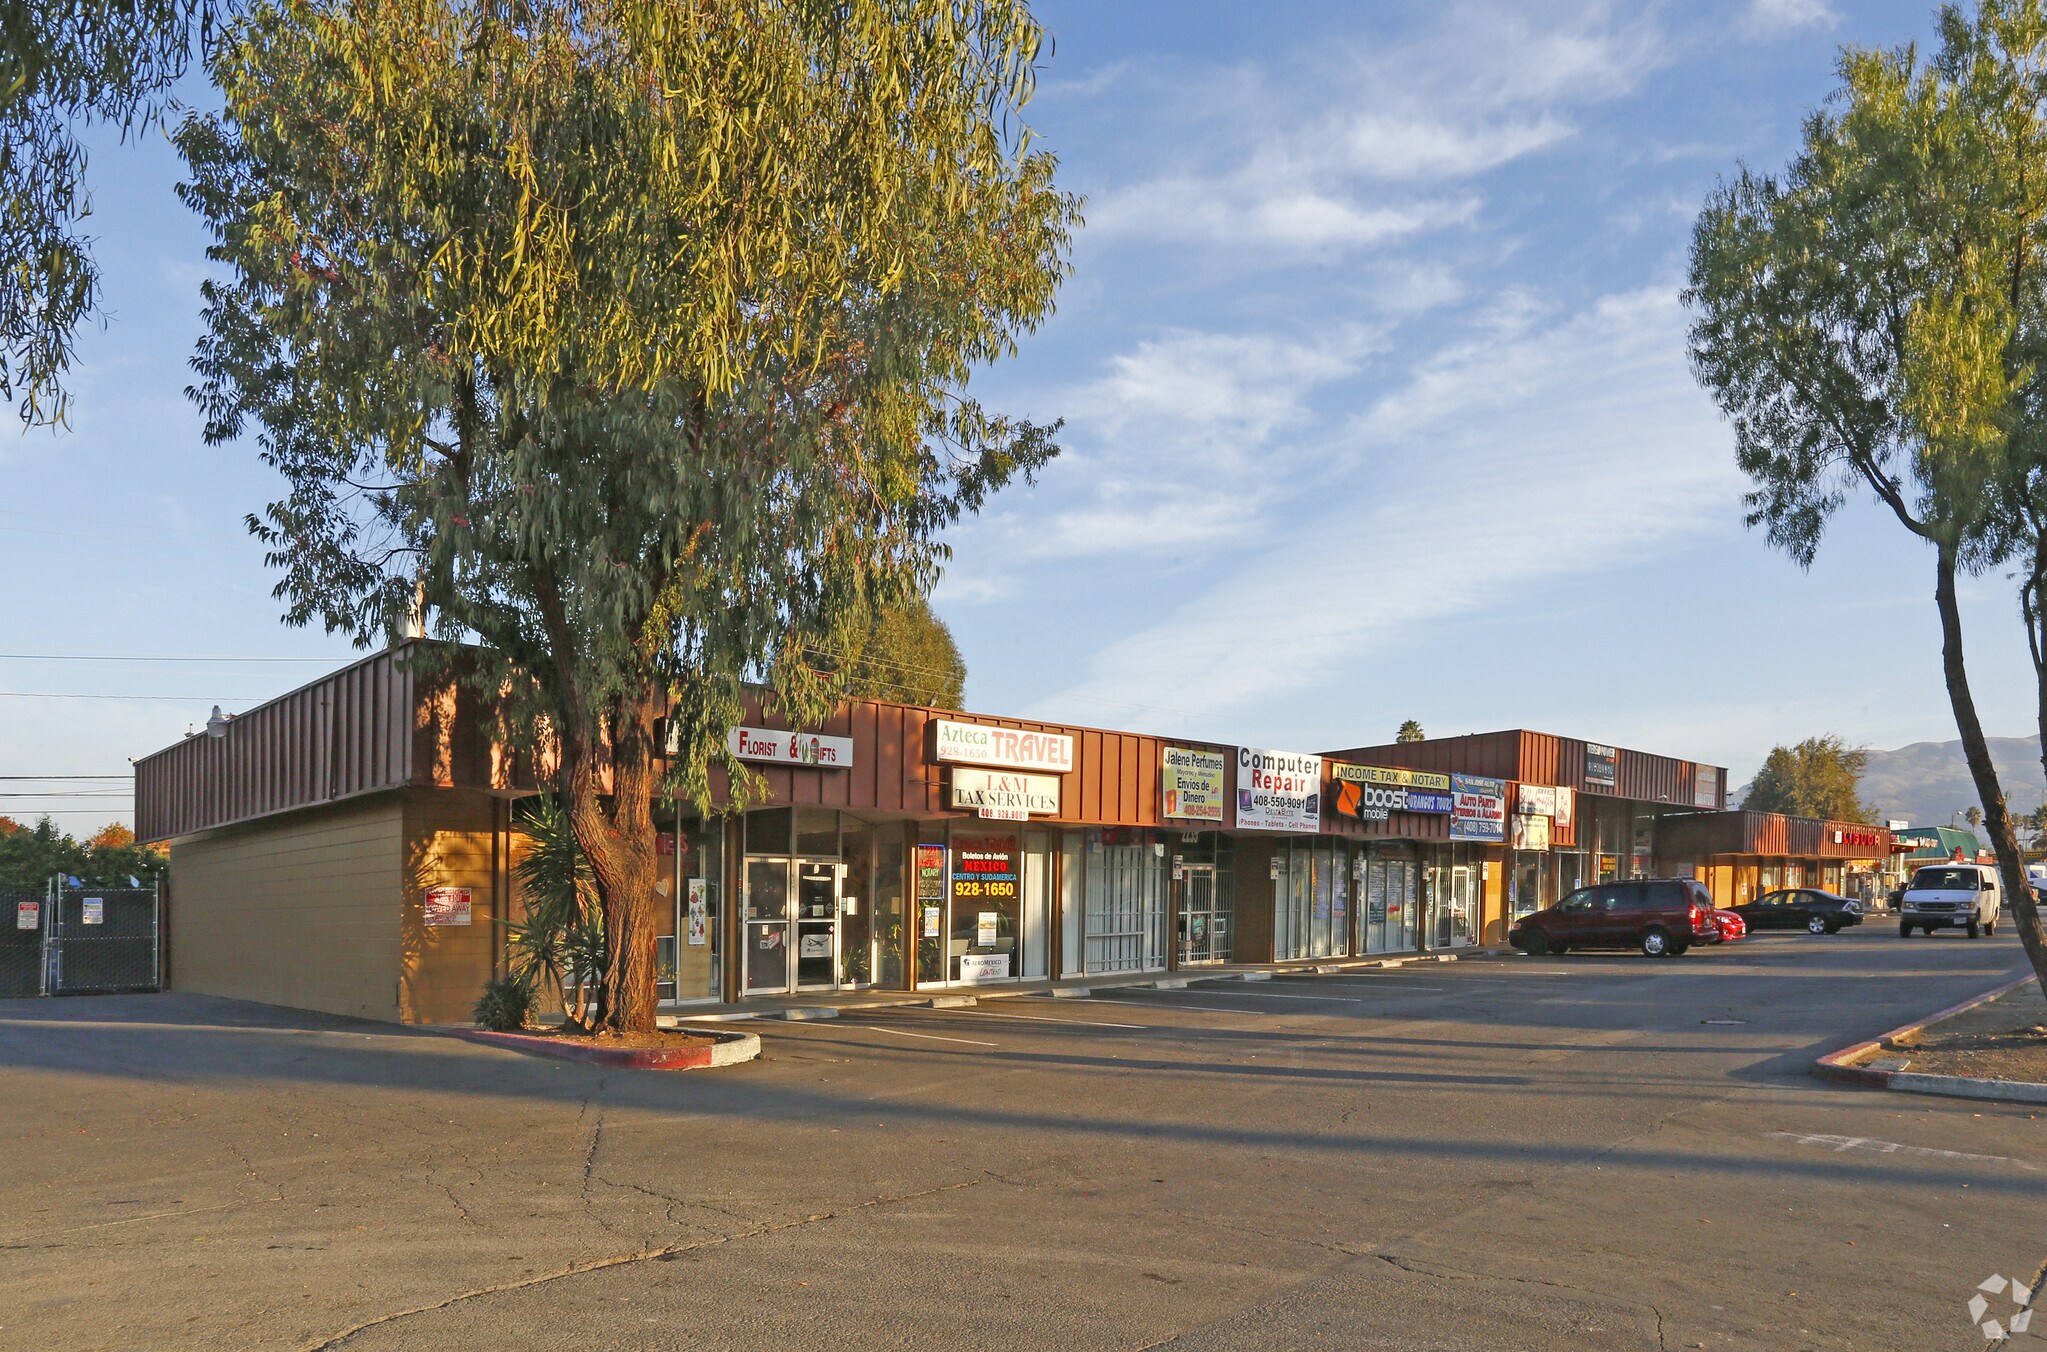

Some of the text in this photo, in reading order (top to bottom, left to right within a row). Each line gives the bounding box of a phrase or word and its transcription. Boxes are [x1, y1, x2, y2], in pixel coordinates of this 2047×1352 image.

[740, 731, 777, 757] FLORIST
[789, 735, 799, 759] &
[942, 725, 1069, 764] Azteca TRAVEL
[940, 745, 988, 760] 928-1650
[1165, 751, 1222, 770] Jalene Perfumes
[1240, 748, 1319, 776] Computer
[987, 775, 1028, 793] L&M
[1178, 777, 1210, 791] Envios de
[1252, 769, 1306, 794] Repair
[1336, 766, 1446, 787] INCOME TAX & NOTARY
[955, 788, 1056, 810] TAX SERVICES
[1183, 791, 1206, 803] Dinero
[1253, 795, 1305, 809] 408-550-9091
[1364, 782, 1408, 809] boost
[1408, 794, 1453, 811] URANGO'S TOURS
[1460, 793, 1496, 809] AUTO PARTS
[1364, 808, 1388, 820] mobile
[1265, 820, 1285, 828] Tablets
[1299, 822, 1317, 830] Phones
[1843, 832, 1880, 847] LIQUOR
[962, 851, 984, 860] Boletos
[984, 852, 992, 860] de
[921, 868, 939, 878] NOTARY
[964, 860, 1008, 872] MEXICO
[952, 873, 1017, 881] CENTRO Y SUDAMERICA
[955, 882, 1014, 896] 928-1650
